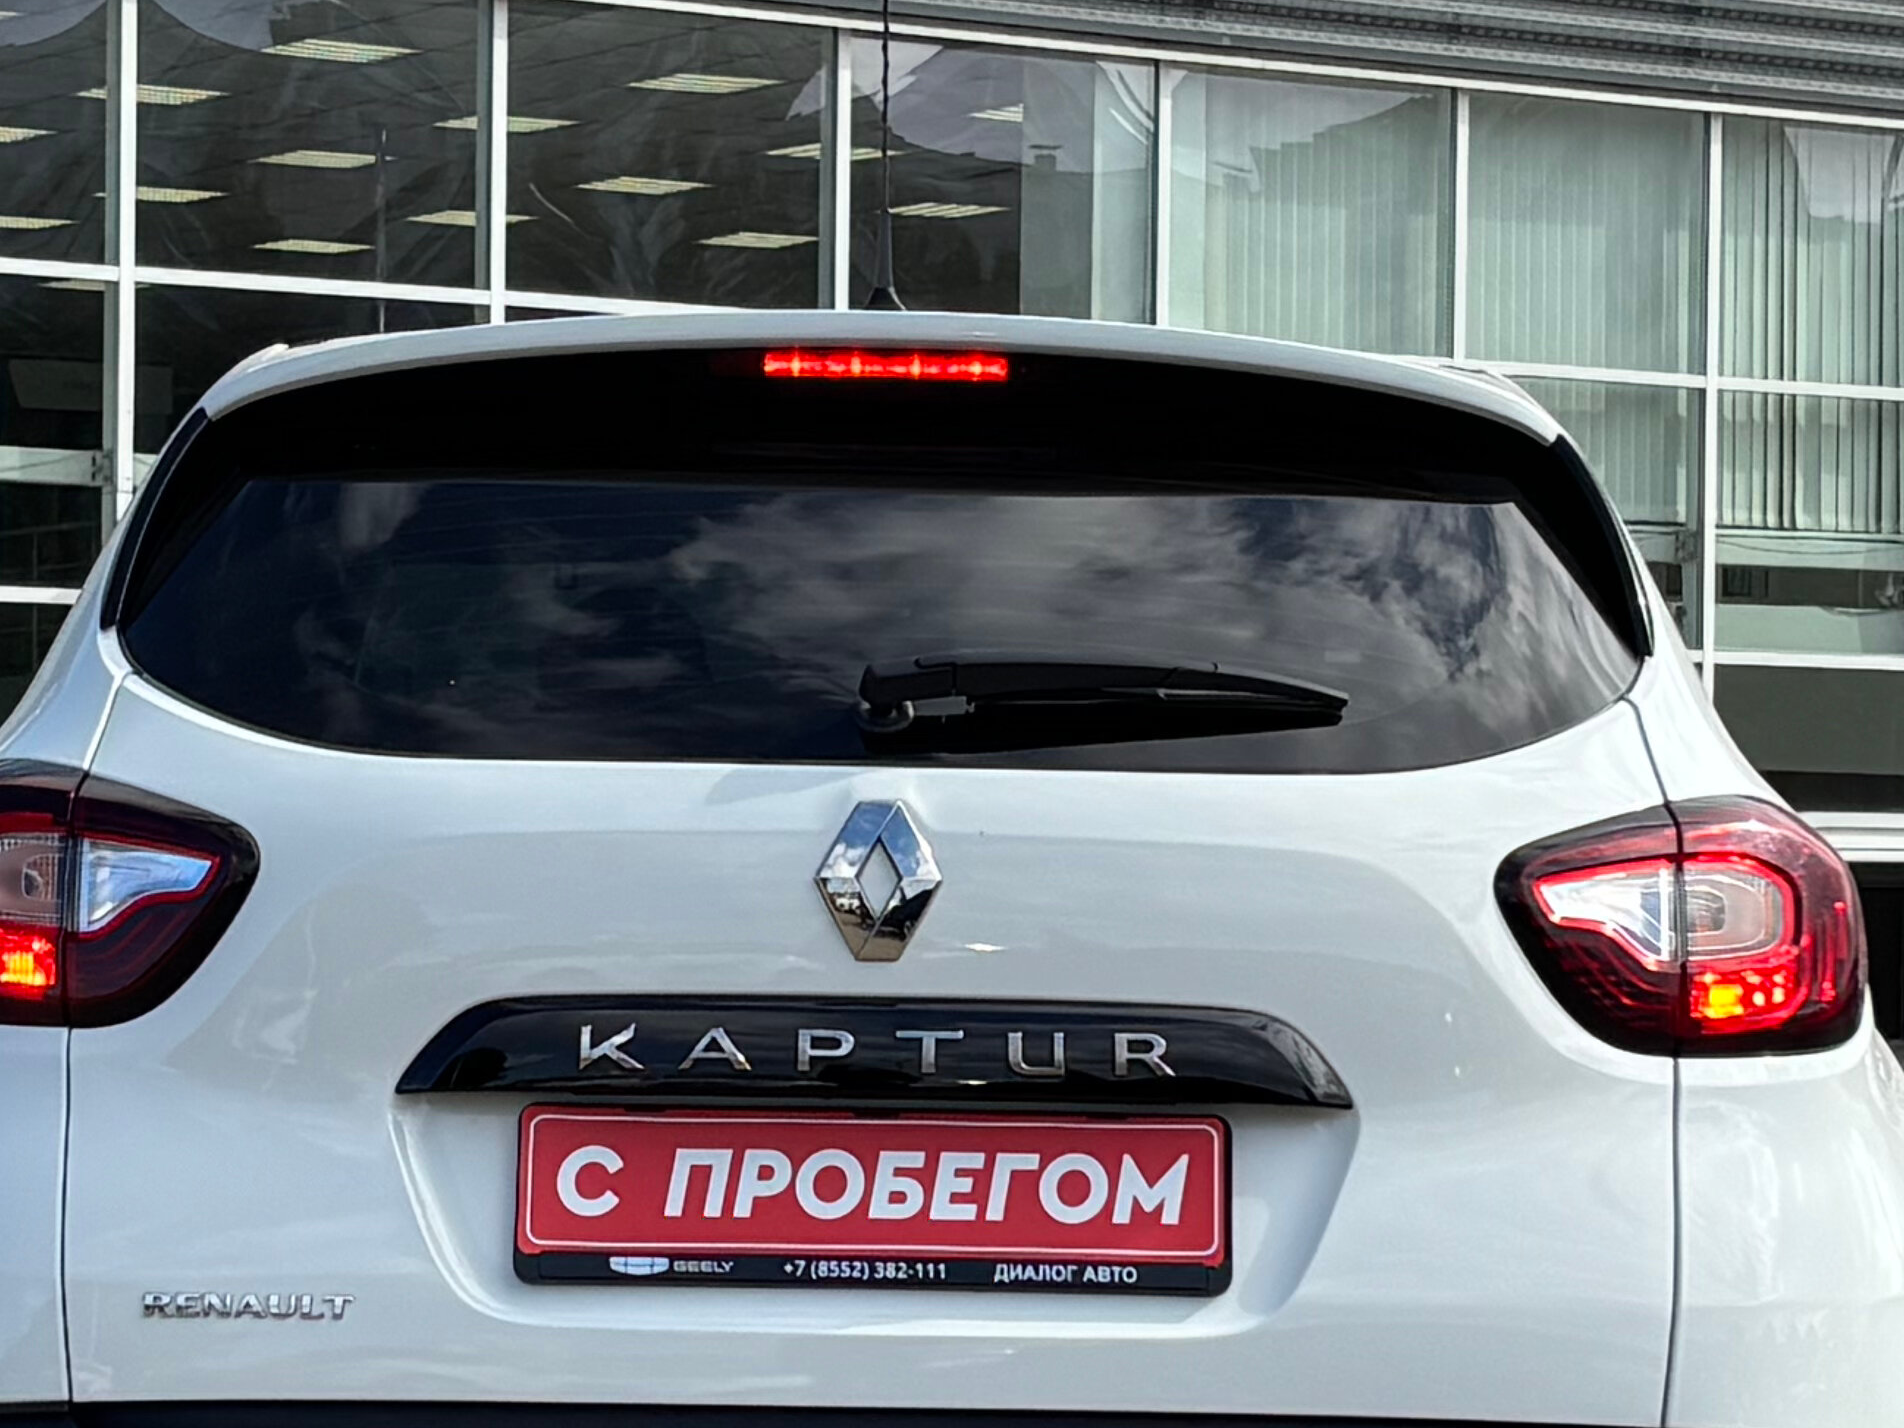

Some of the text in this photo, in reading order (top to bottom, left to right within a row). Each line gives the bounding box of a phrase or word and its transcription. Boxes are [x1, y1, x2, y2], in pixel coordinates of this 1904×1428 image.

[579, 1023, 1177, 1078] KAPTUR
[556, 1145, 1190, 1224] С ПРОБЕГОМ
[673, 1260, 734, 1273] GEELY
[994, 1263, 1138, 1283] ДИАЛОГ АВТО
[142, 1291, 354, 1320] RENAULT
